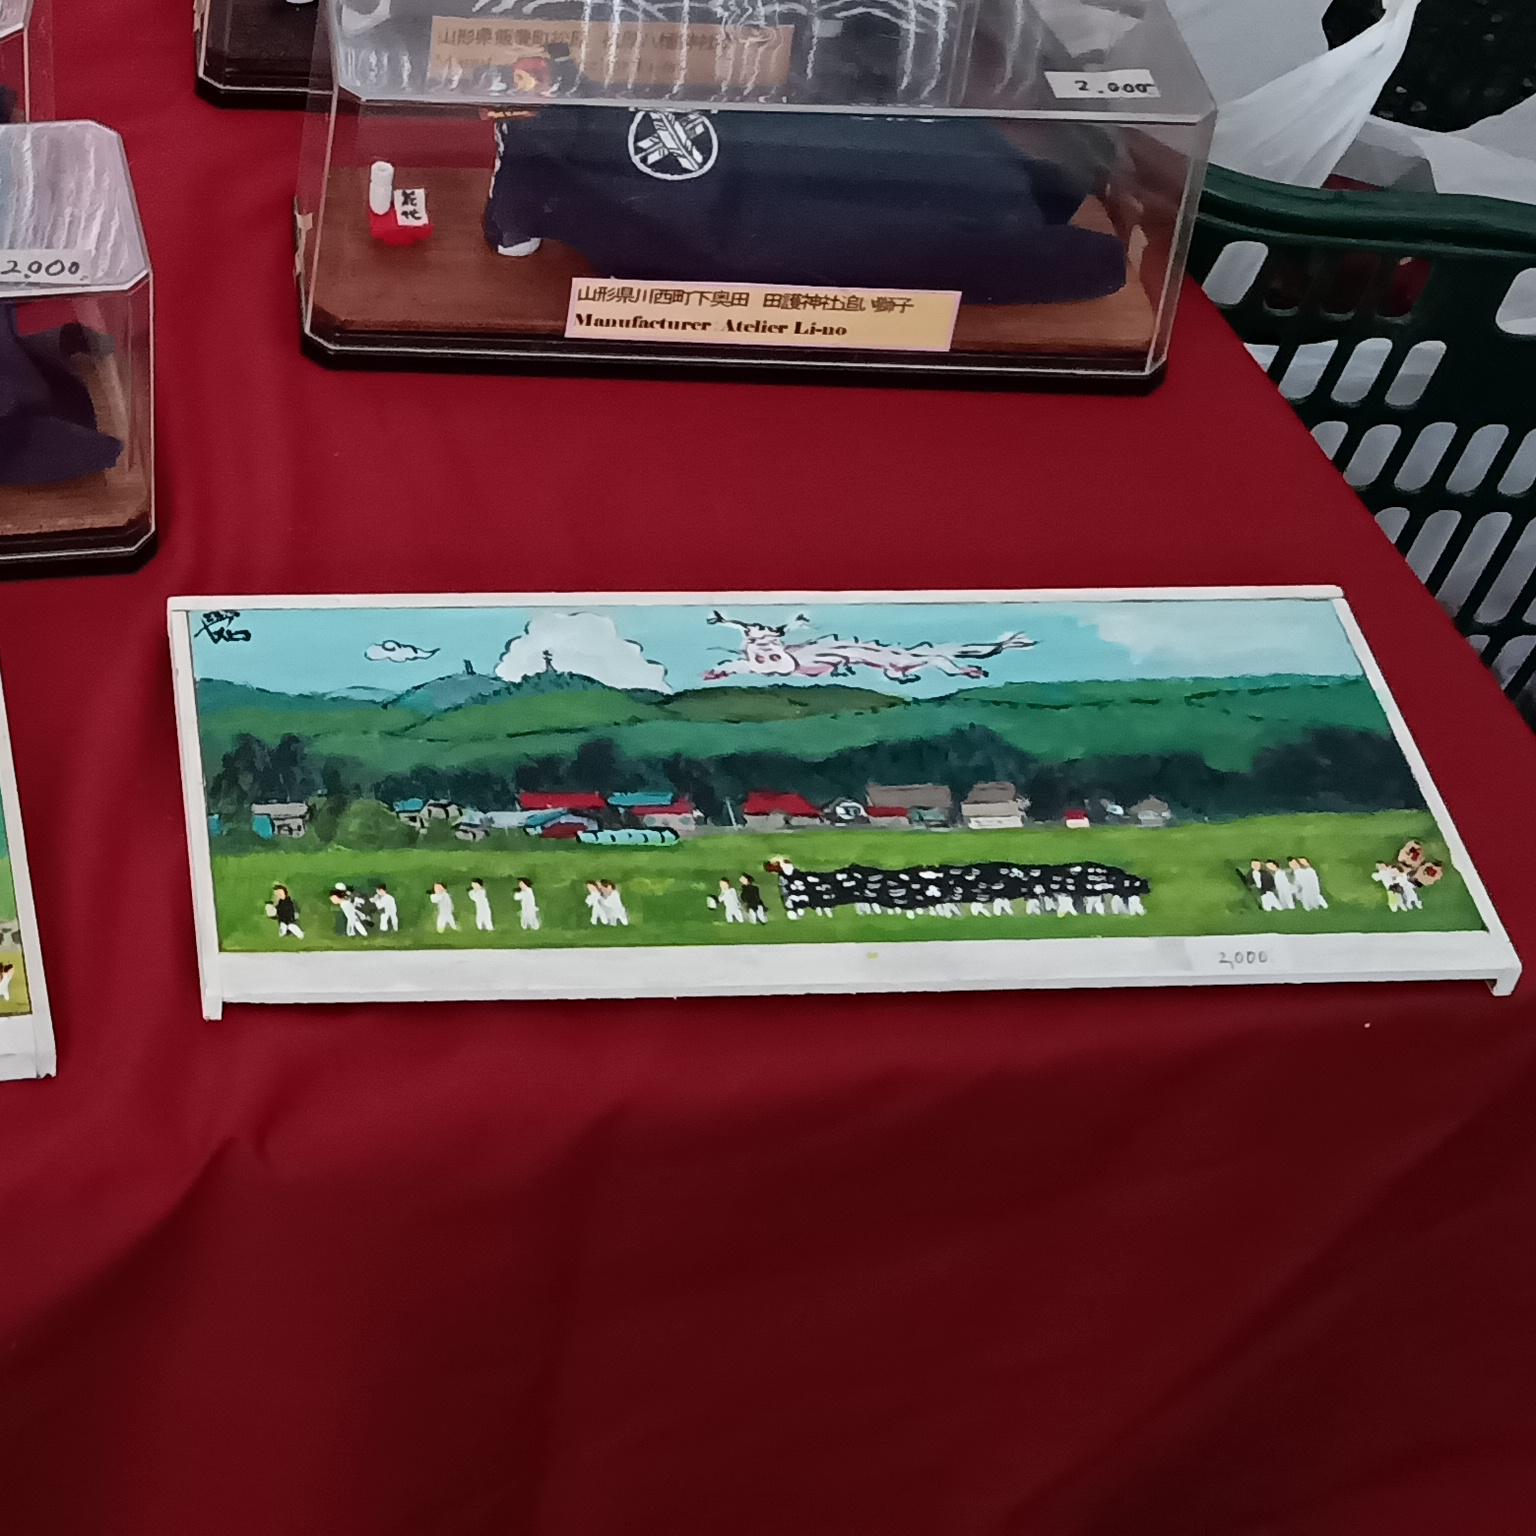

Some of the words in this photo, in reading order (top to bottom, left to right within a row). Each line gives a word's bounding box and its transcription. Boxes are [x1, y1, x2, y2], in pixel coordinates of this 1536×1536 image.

[575, 312, 712, 333] Manufacturer
[723, 317, 789, 335] Atelier
[794, 321, 847, 337] Li-no
